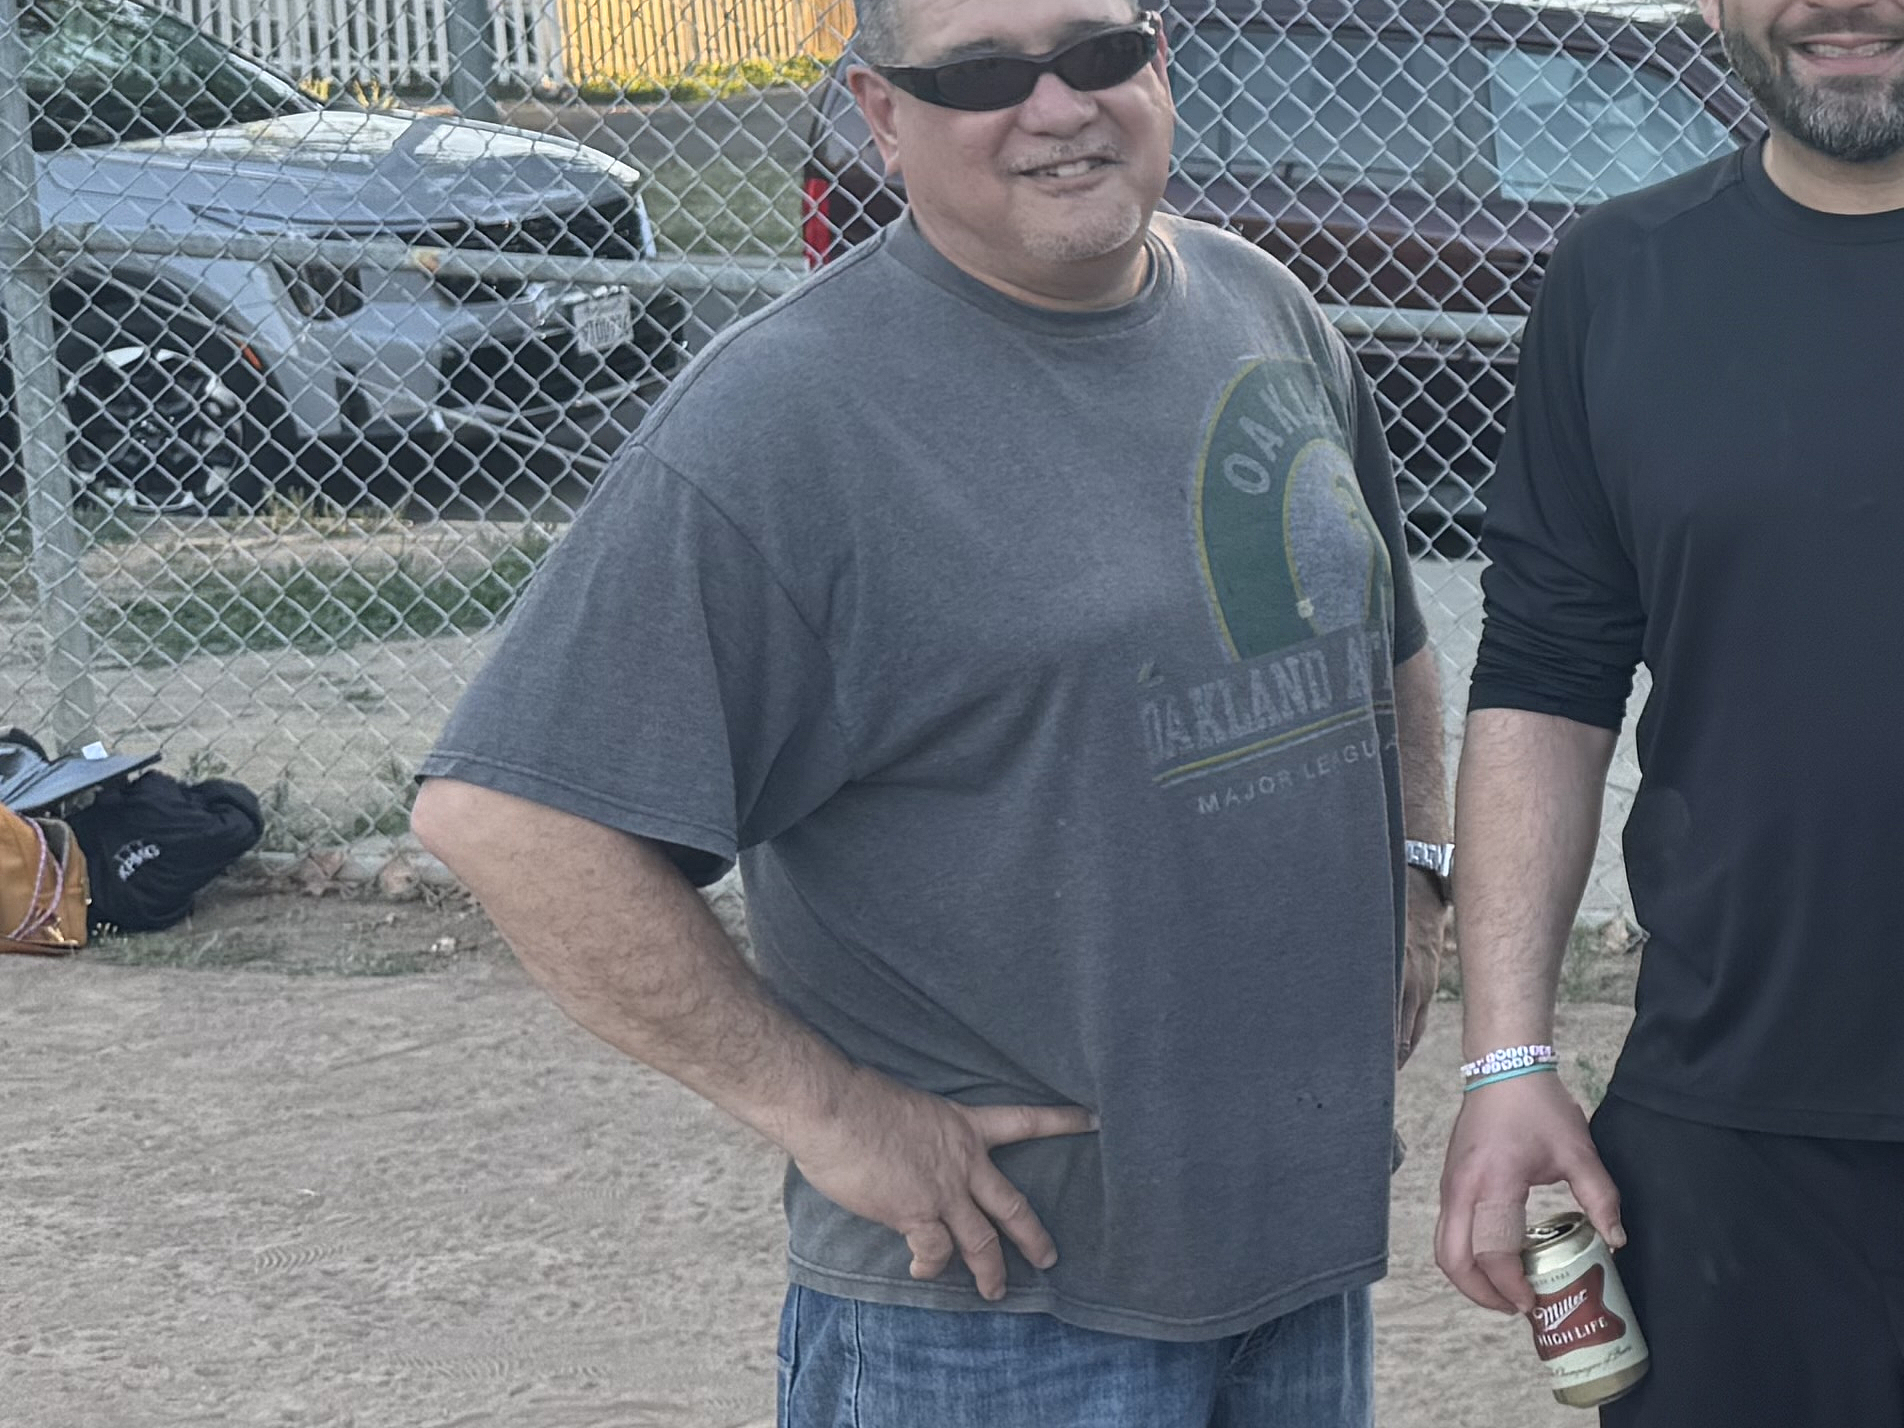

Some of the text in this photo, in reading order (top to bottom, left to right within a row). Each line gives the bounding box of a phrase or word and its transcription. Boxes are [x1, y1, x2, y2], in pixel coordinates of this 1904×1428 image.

[1140, 649, 1333, 764] OAKLAND
[1197, 771, 1294, 815] MAJOR
[1302, 740, 1381, 780] LEAGU
[1532, 1288, 1589, 1332] Miller
[1538, 1316, 1608, 1347] HIGH LIFE
